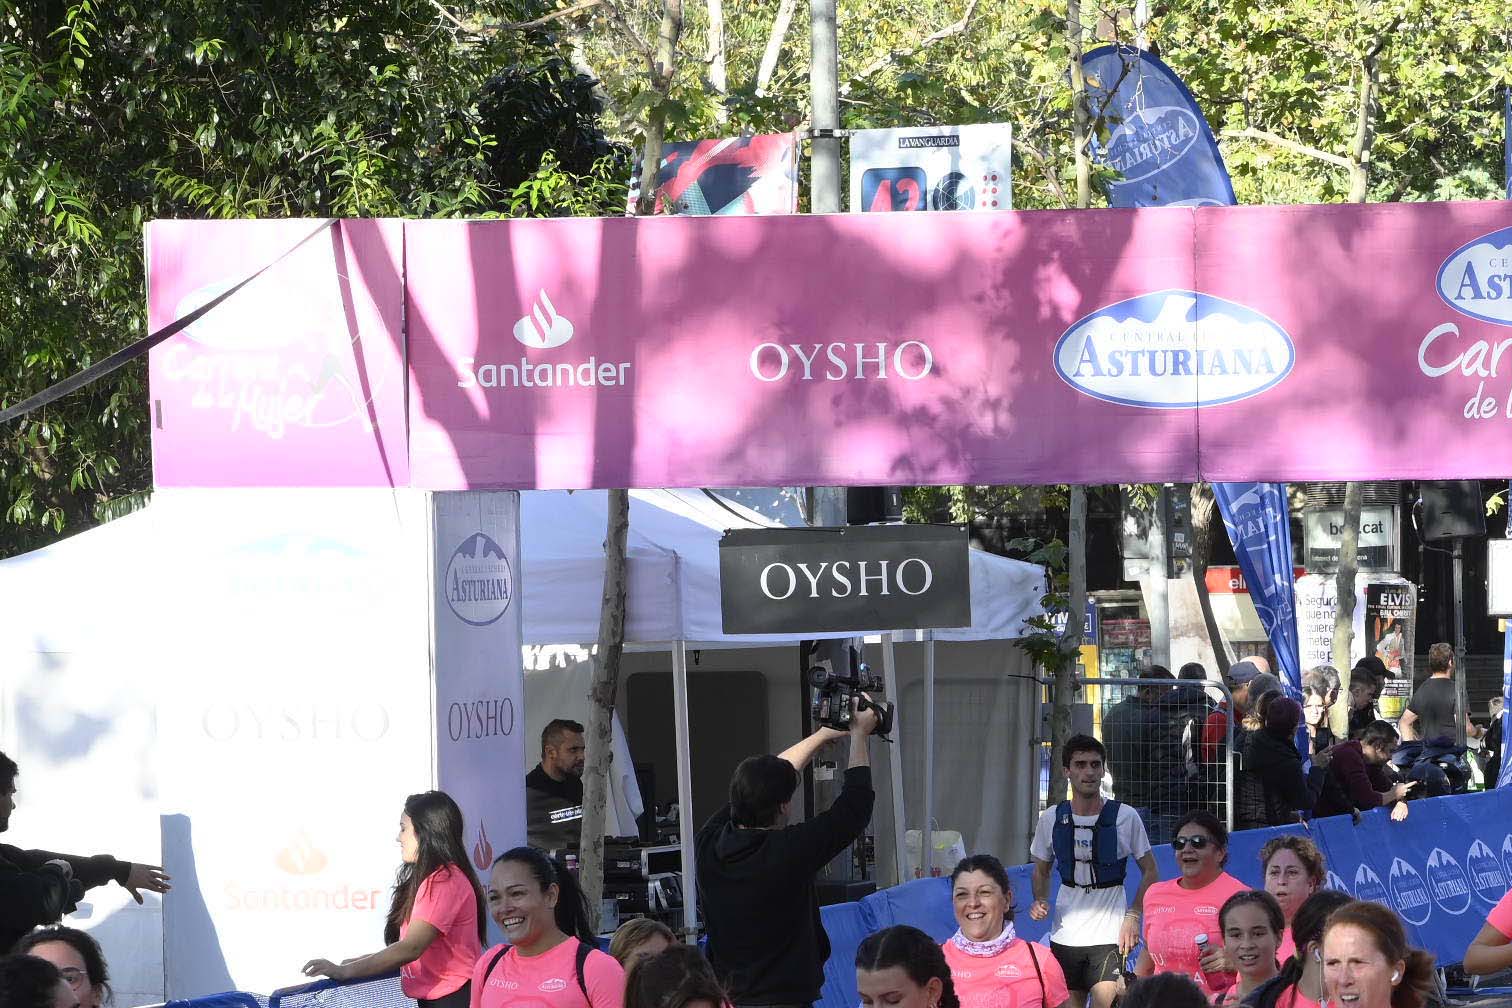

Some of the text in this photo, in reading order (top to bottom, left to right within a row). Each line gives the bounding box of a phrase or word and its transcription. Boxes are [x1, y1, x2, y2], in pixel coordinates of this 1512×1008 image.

[900, 137, 959, 148] LA VANGUARDIA
[457, 357, 631, 389] Santander
[749, 341, 933, 382] OYSHO
[1073, 334, 1277, 377] ASTURIANA
[1464, 382, 1499, 420] de
[450, 568, 510, 604] ASTURIANA
[761, 557, 934, 601] OYSHO
[1379, 593, 1412, 607] ELVIS
[448, 697, 515, 743] OYSHO
